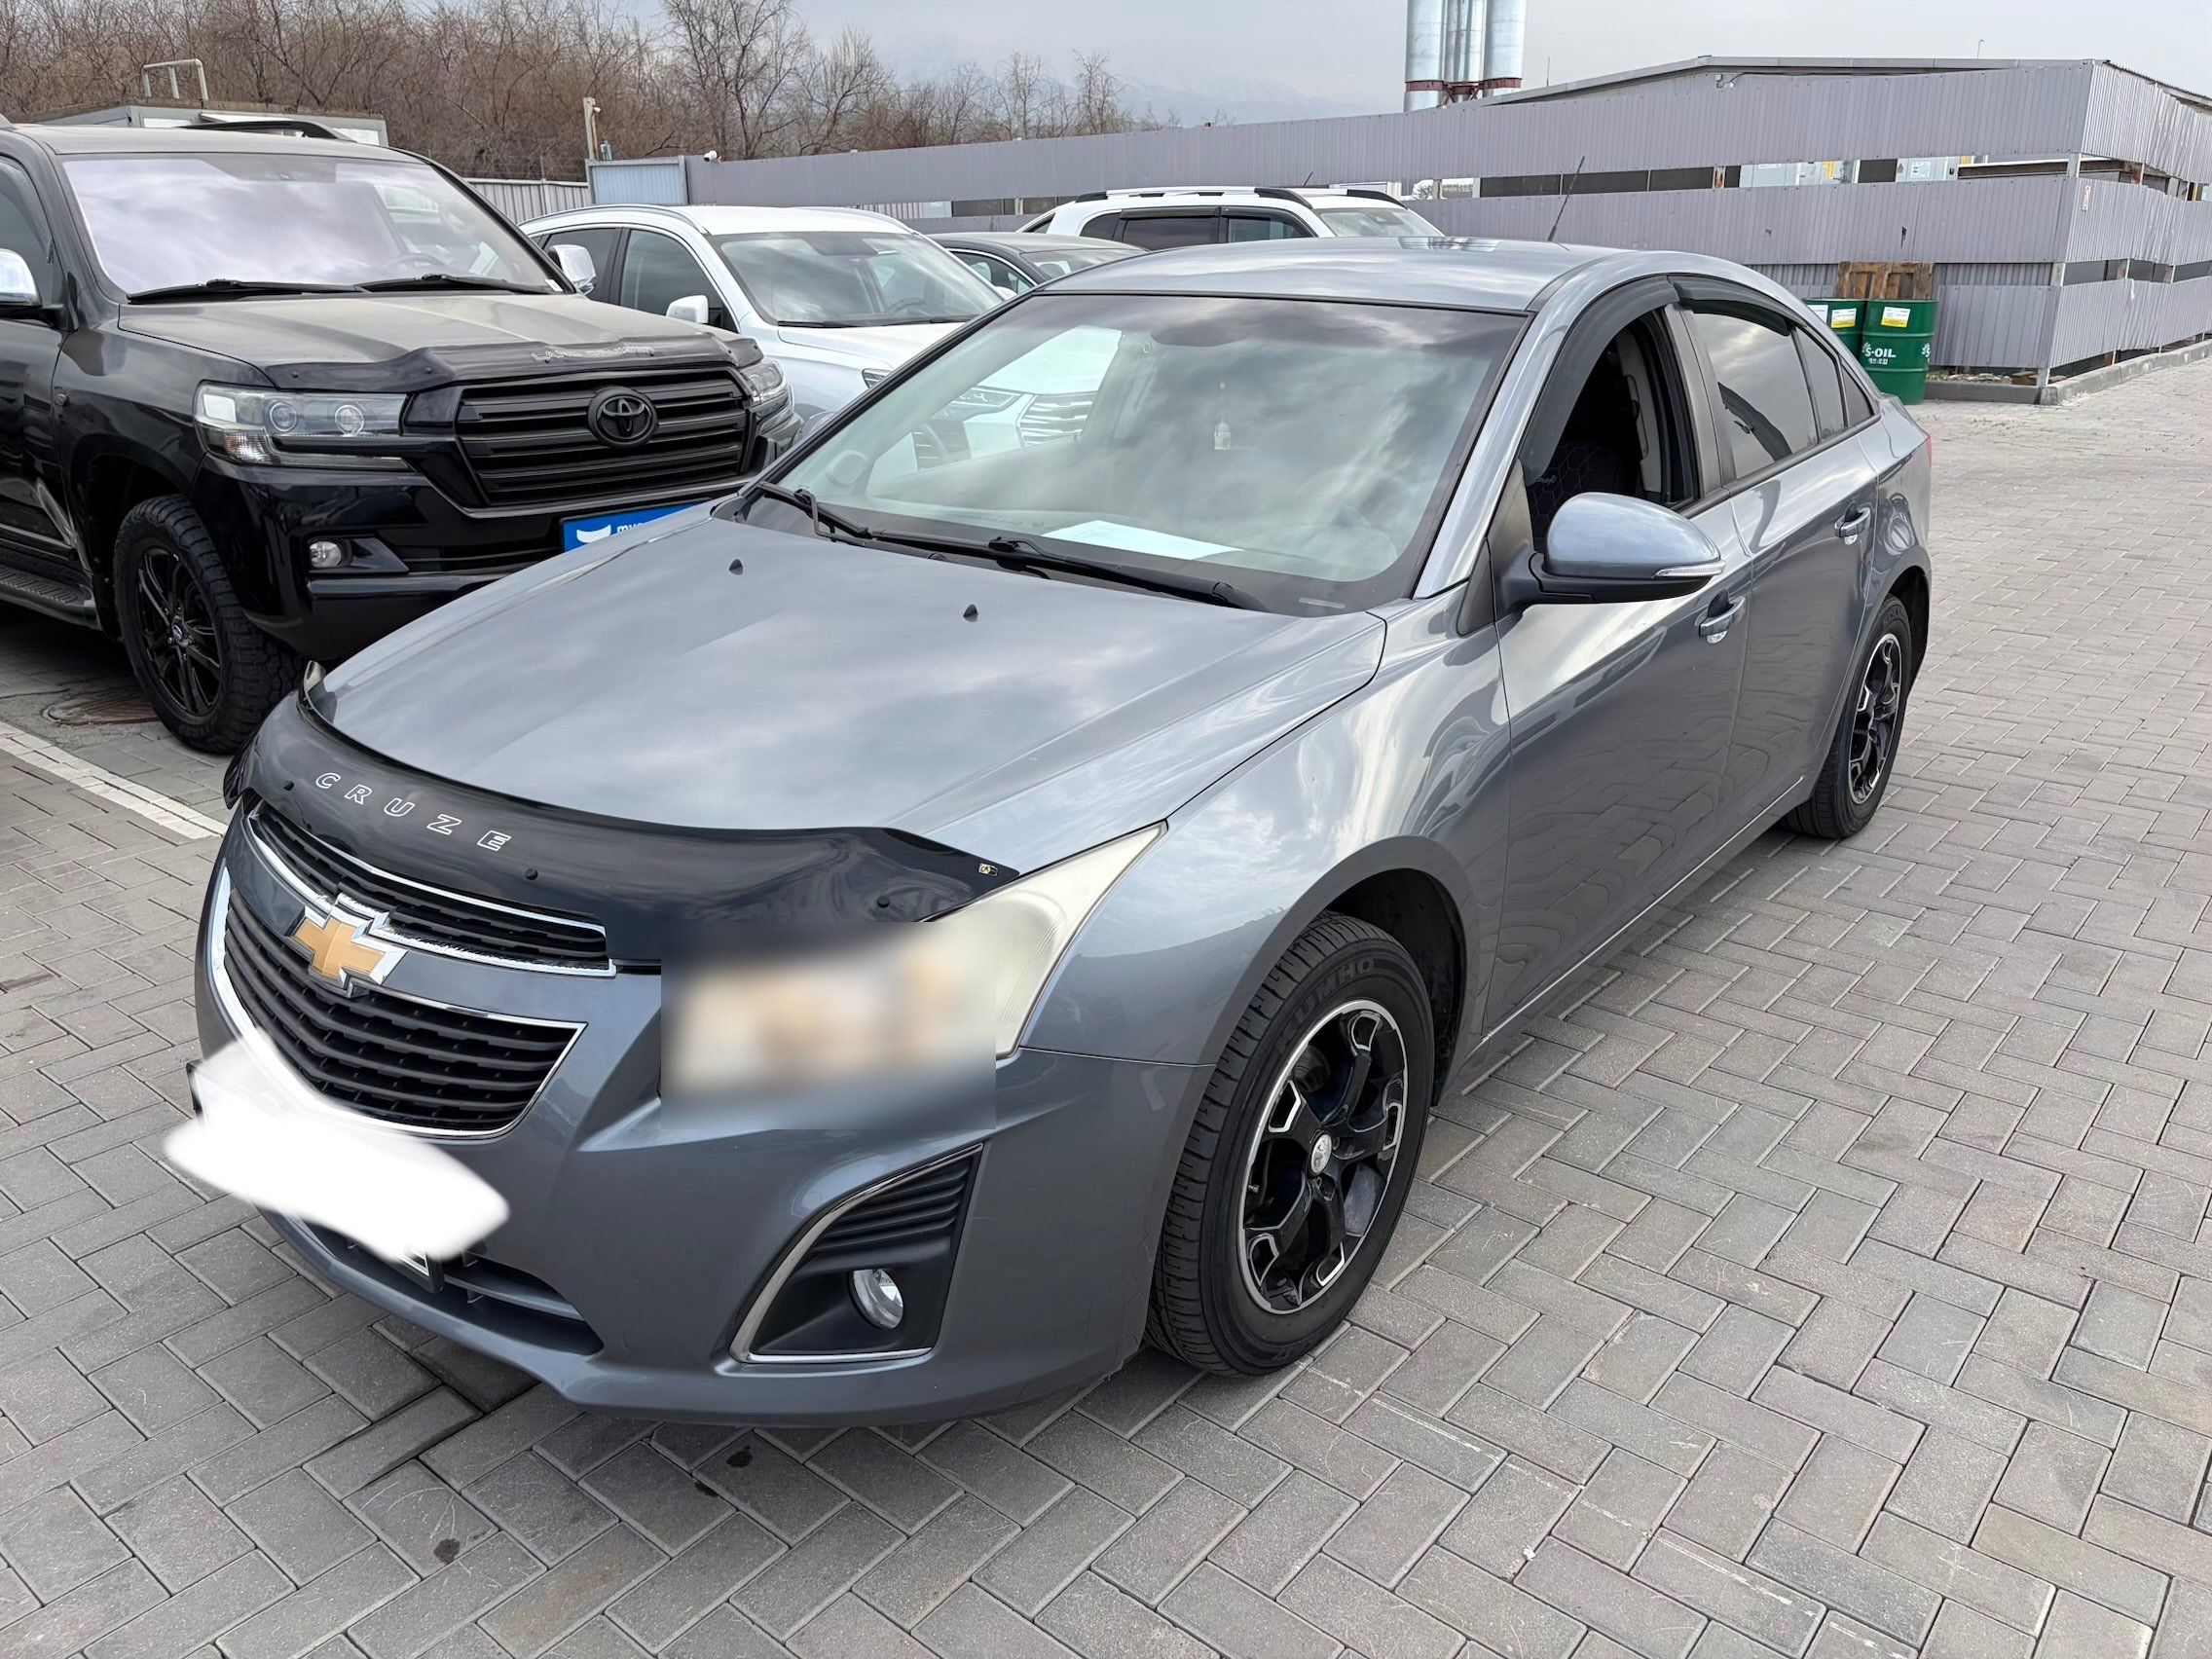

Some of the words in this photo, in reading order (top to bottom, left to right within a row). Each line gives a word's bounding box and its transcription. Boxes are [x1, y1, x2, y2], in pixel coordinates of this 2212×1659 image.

[1863, 347, 1897, 358] S-OIL
[315, 772, 511, 852] CRUZE
[1274, 957, 1375, 1054] KUMHO
